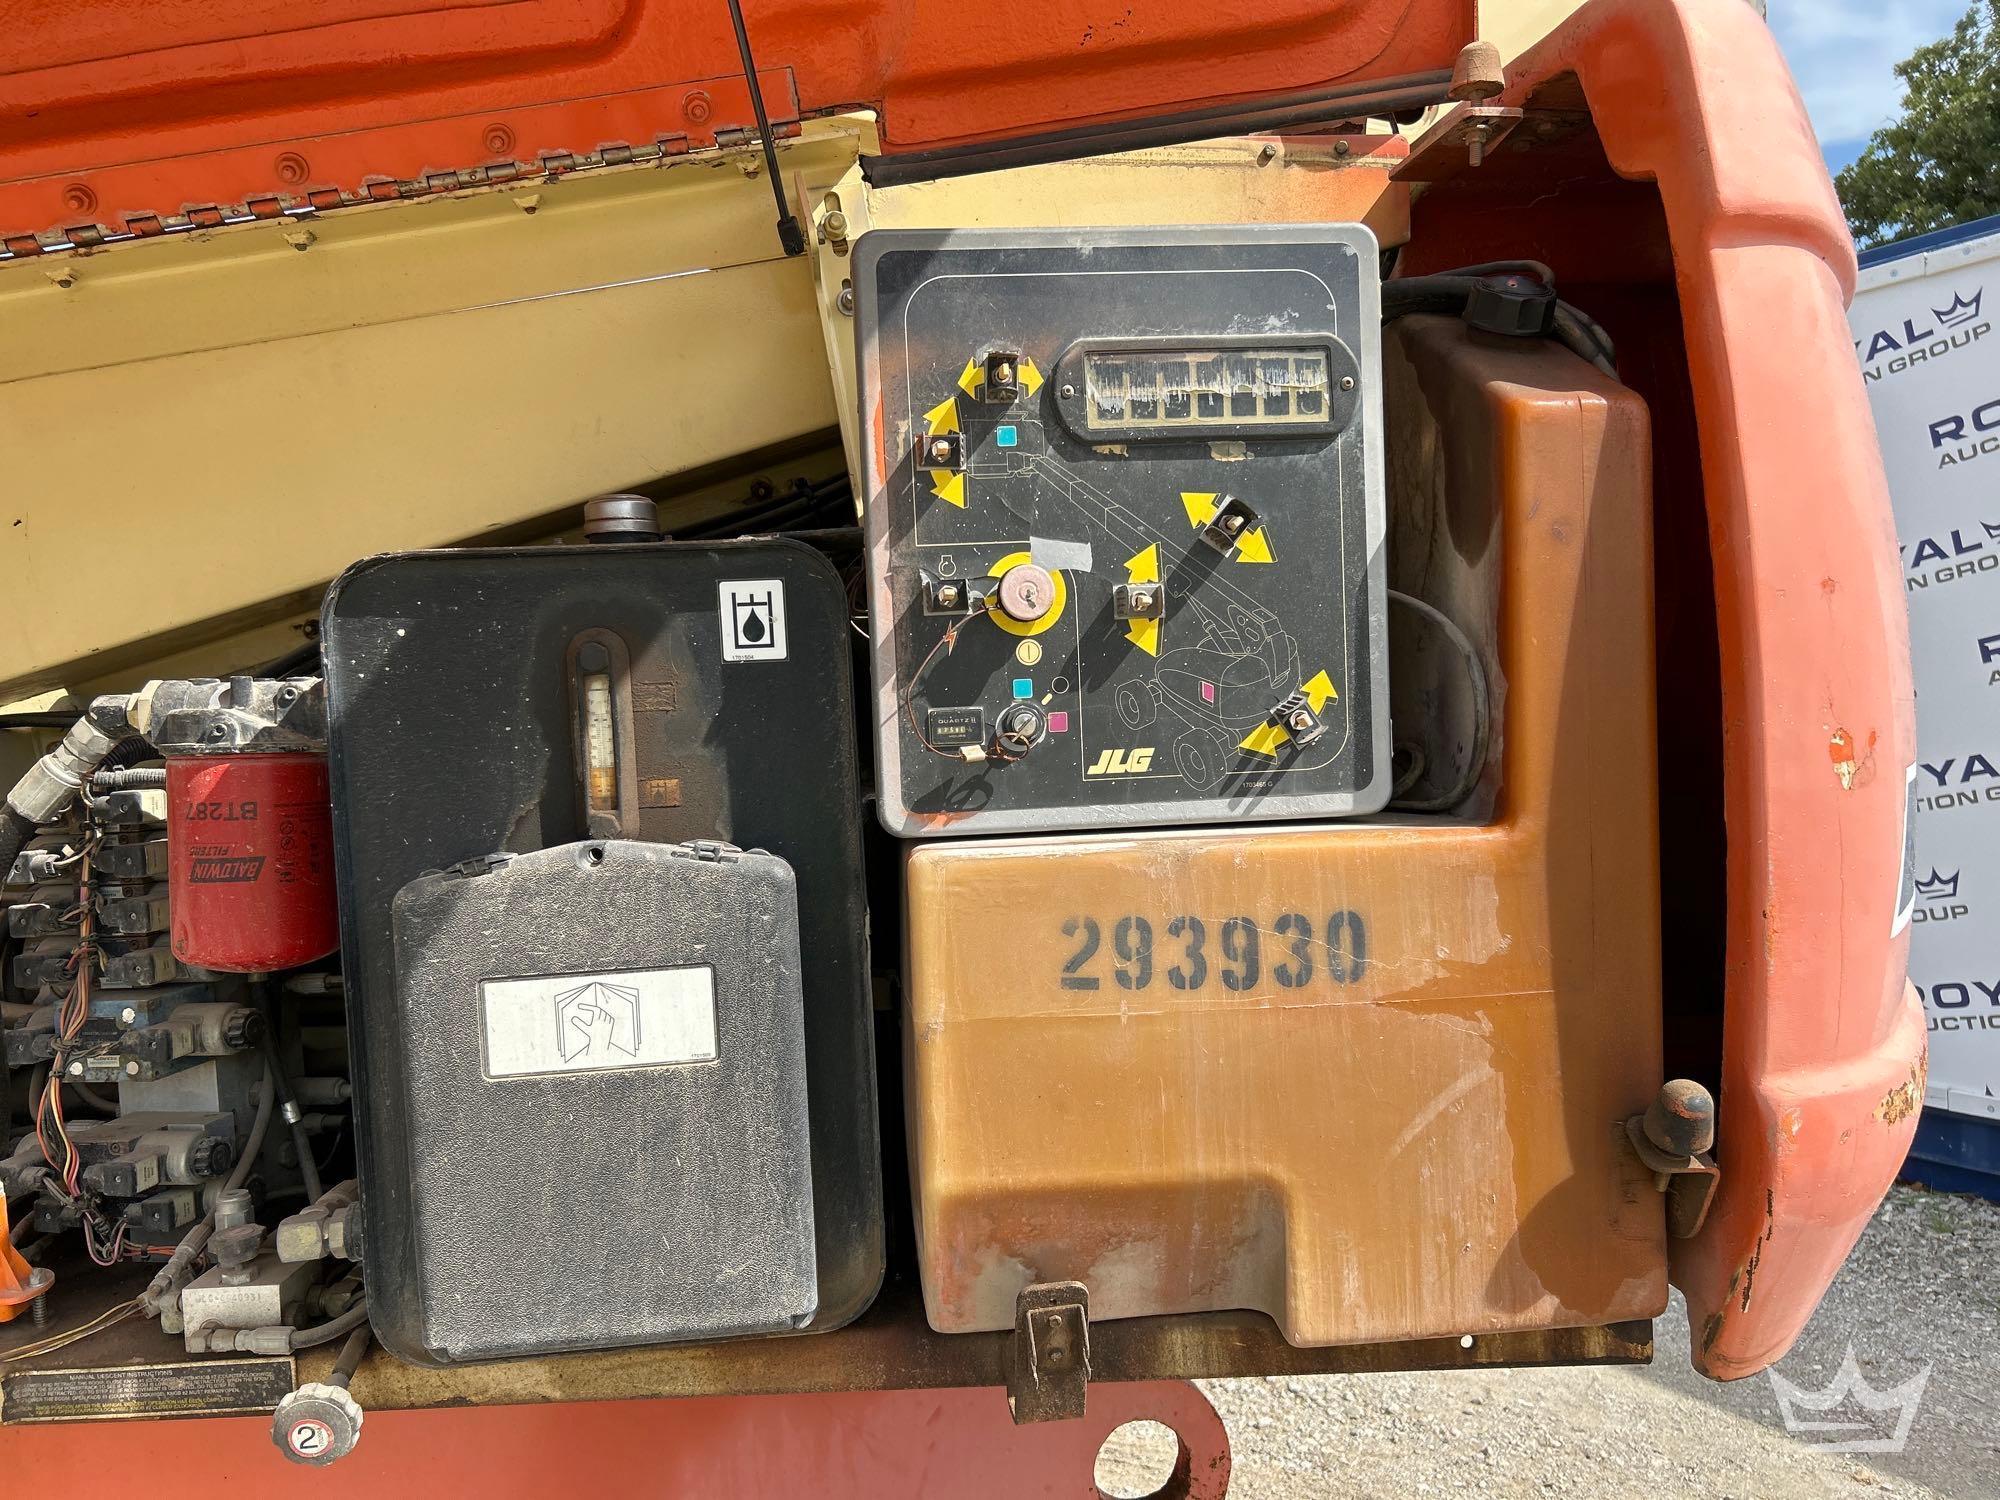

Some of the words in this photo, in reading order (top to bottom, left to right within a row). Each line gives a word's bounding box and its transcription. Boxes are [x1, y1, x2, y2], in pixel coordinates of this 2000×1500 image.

[1855, 319, 1934, 363] AL
[1888, 322, 1991, 374] GROUP
[1900, 529, 1983, 570] AL
[1934, 554, 1999, 584] GRO
[1087, 748, 1155, 774] JLG
[1919, 754, 2000, 787] YA
[186, 801, 258, 821] BT287
[193, 861, 260, 879] BALDWIN
[1060, 910, 1367, 990] 293930
[97, 1372, 125, 1380] DESCENT
[127, 1370, 172, 1378] INSTRUCTIONS
[297, 1426, 318, 1449] 2
